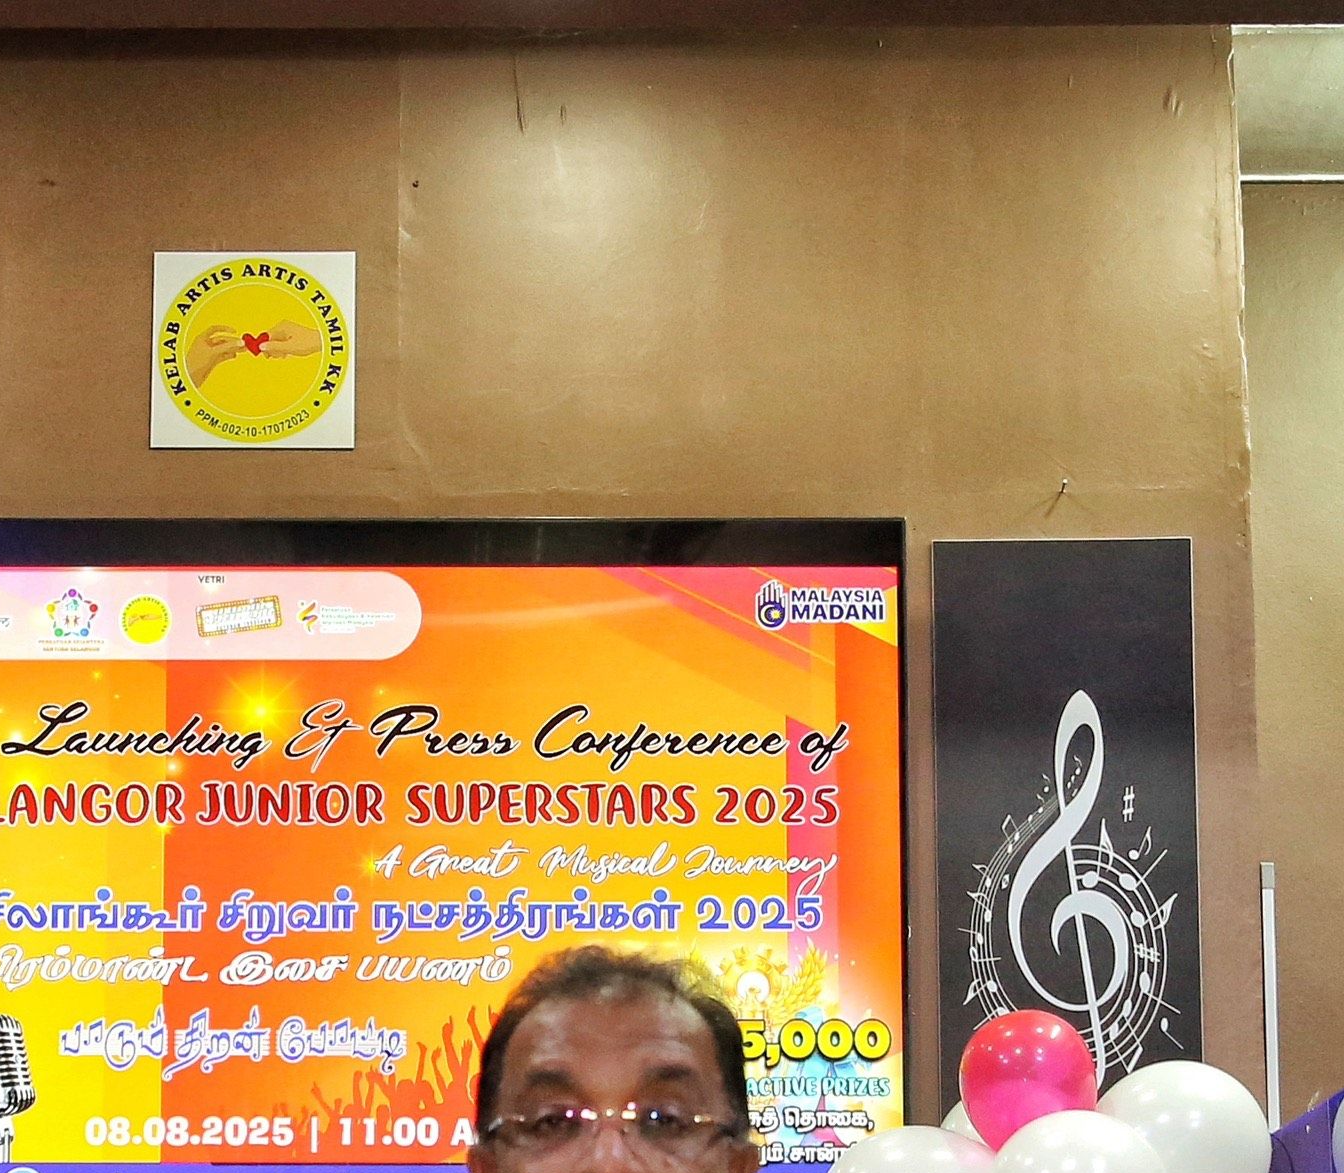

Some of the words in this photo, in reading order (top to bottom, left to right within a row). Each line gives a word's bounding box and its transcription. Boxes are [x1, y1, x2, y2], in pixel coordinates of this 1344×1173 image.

[178, 267, 233, 316] ARTIS
[242, 264, 309, 291] ARTIS
[311, 290, 344, 357] TAMIL
[163, 321, 187, 396] KELAB
[319, 364, 342, 395] KK
[196, 409, 311, 437] PPM-002-10-17072023
[791, 588, 884, 603] MALAYSIA
[791, 603, 885, 623] MADANI
[2, 702, 272, 769] Launching
[370, 704, 521, 759] Press
[533, 705, 797, 774] Conference
[800, 722, 851, 774] of
[198, 782, 385, 826] JUNIOR
[406, 782, 697, 826] SUPERSTARS
[714, 786, 840, 826] 2025
[375, 843, 403, 879] A
[409, 839, 530, 880] Great
[539, 842, 679, 884] Musical
[684, 843, 839, 896] Journey
[216, 887, 357, 941] சிறுவர்
[371, 887, 682, 941] நட்சத்திரங்கள்
[696, 895, 824, 932] 2025
[218, 947, 348, 986] இசை
[355, 944, 513, 986] பயணம்
[746, 1075, 818, 1097] ACTIVE
[821, 1075, 891, 1098] PRIZES
[85, 1116, 294, 1148] 08.08.2025
[339, 1116, 439, 1148] 11.00
[450, 1117, 480, 1147] A
